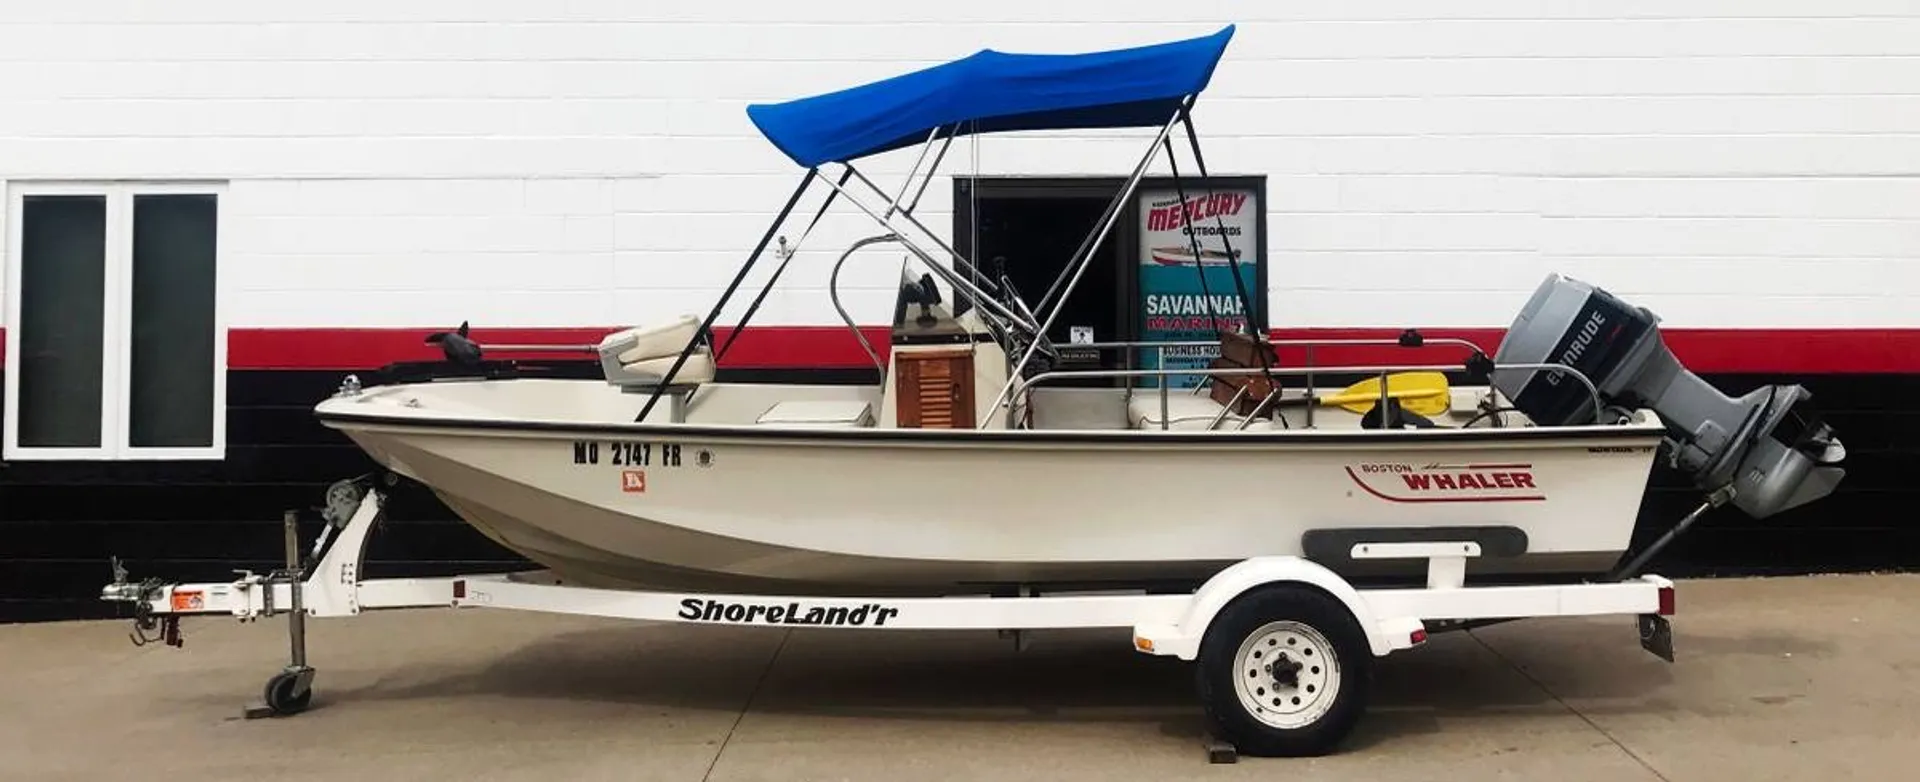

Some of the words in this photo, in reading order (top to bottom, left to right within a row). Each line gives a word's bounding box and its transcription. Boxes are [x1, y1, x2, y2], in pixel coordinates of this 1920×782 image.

[1147, 192, 1246, 232] MERCURY
[1182, 226, 1242, 236] OUTBOARDS
[1163, 345, 1203, 357] BUSINESS
[574, 441, 599, 464] MO
[611, 442, 651, 466] 2747
[662, 443, 682, 467] FR
[1361, 464, 1412, 473] BOSTON
[1402, 473, 1537, 490] WHALER
[678, 598, 898, 626] ShoreLand'r
